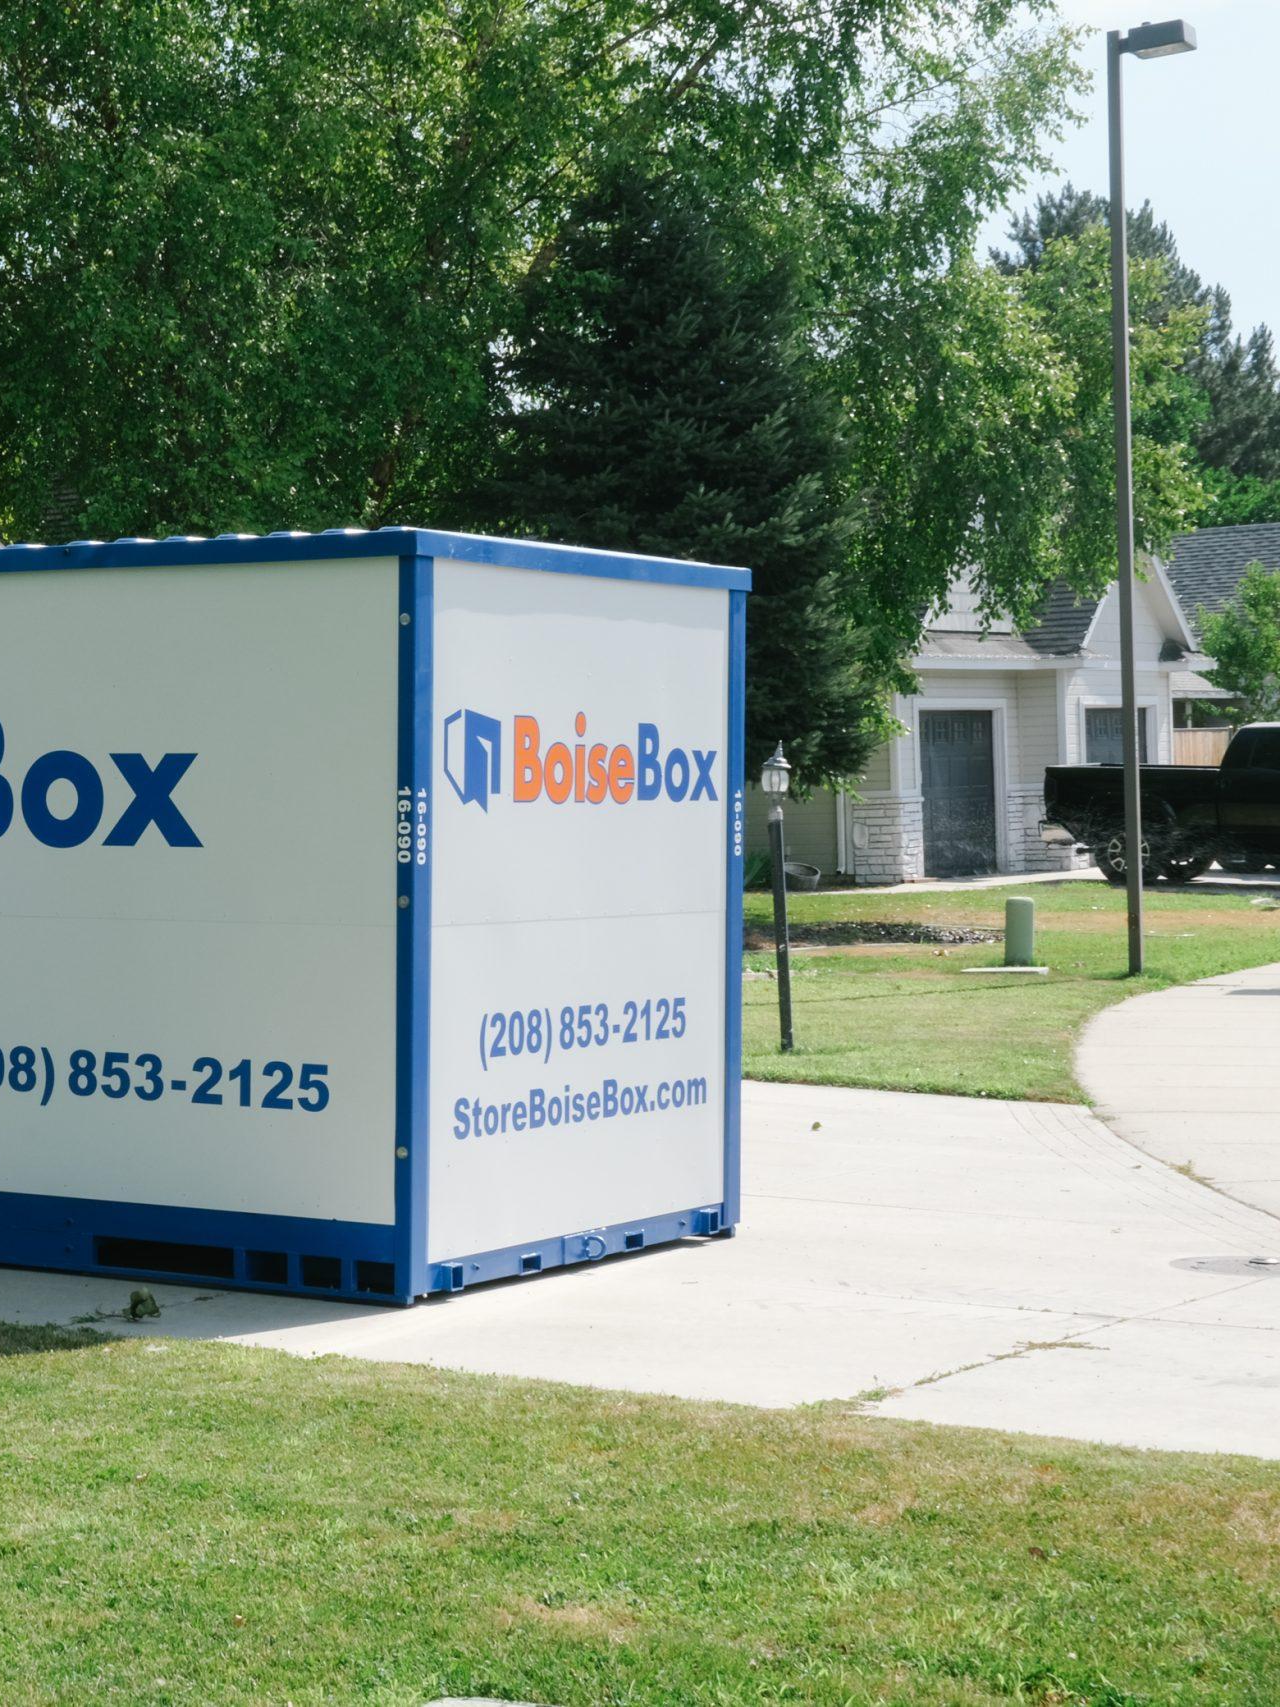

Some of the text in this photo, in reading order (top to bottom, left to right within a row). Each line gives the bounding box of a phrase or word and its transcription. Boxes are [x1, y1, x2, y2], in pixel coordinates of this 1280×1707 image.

[513, 711, 719, 805] BoiseBox
[398, 786, 412, 864] 16-090
[417, 788, 427, 865] 16-090
[734, 789, 742, 857] 16-090
[453, 1076, 707, 1140] StoreBoiseBox.com
